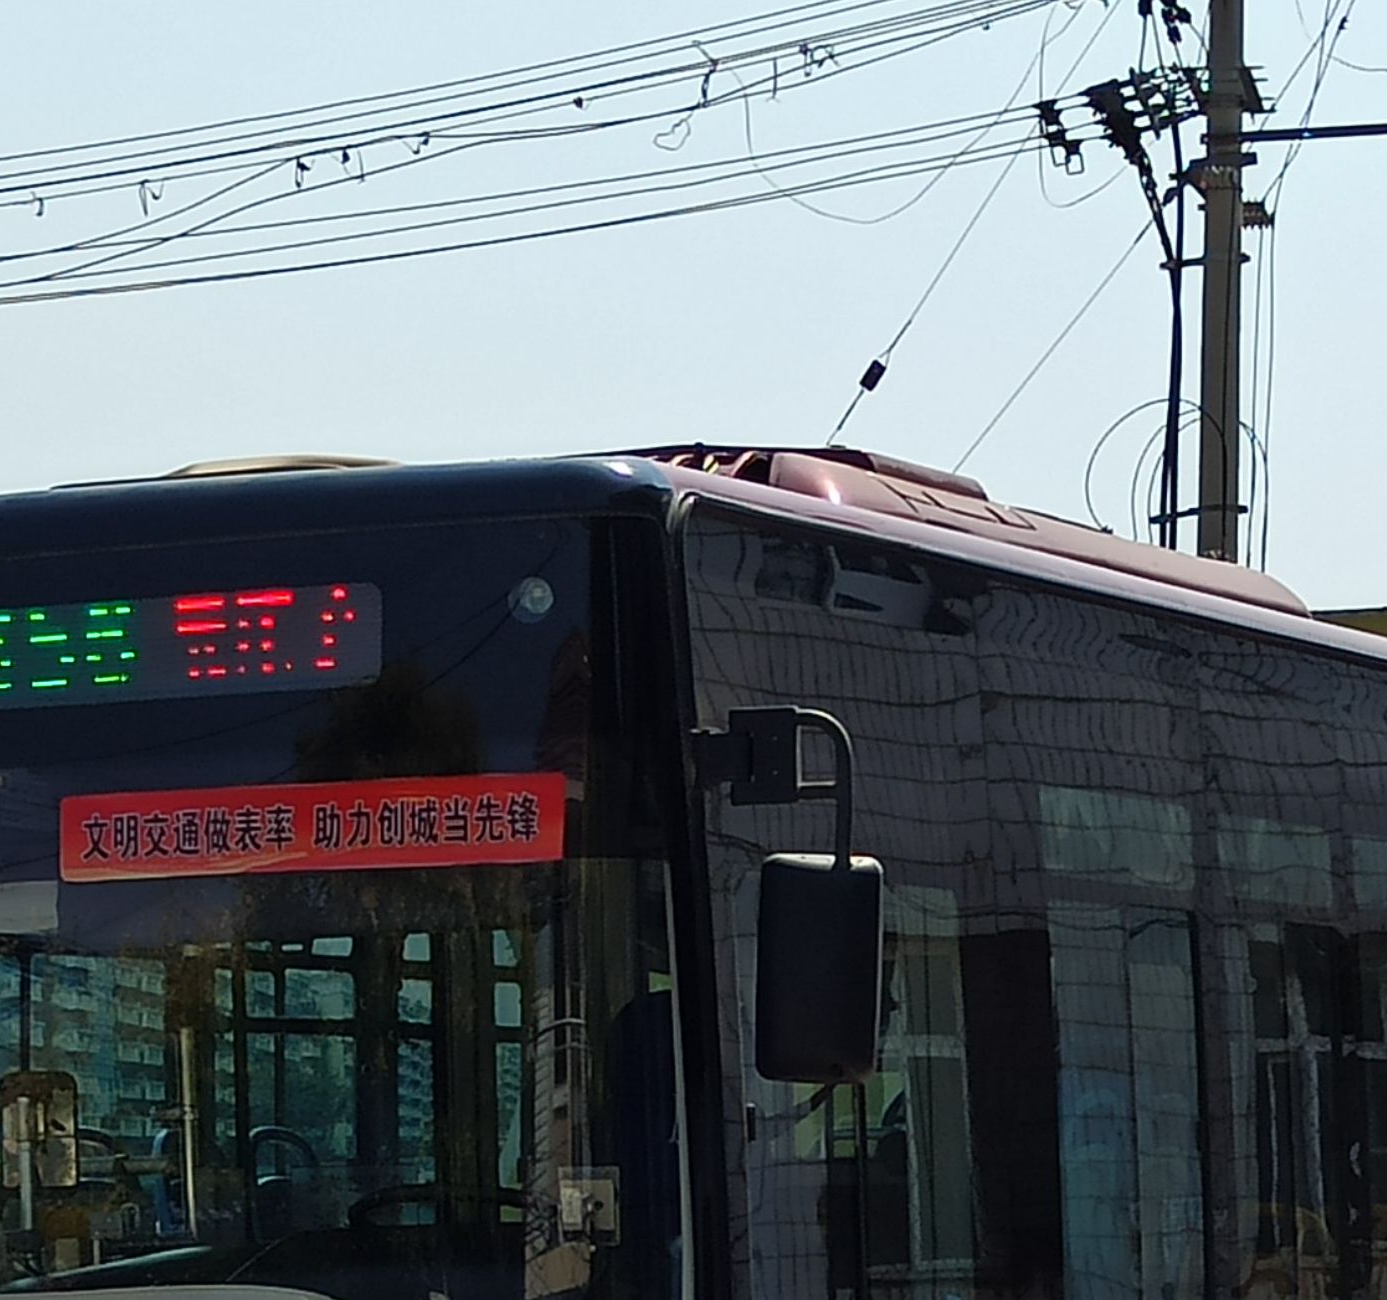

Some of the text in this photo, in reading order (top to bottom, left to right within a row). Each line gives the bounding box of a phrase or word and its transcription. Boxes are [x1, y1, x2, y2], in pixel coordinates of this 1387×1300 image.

[82, 792, 540, 859] 文明交通做表率 助力创城当先锋
